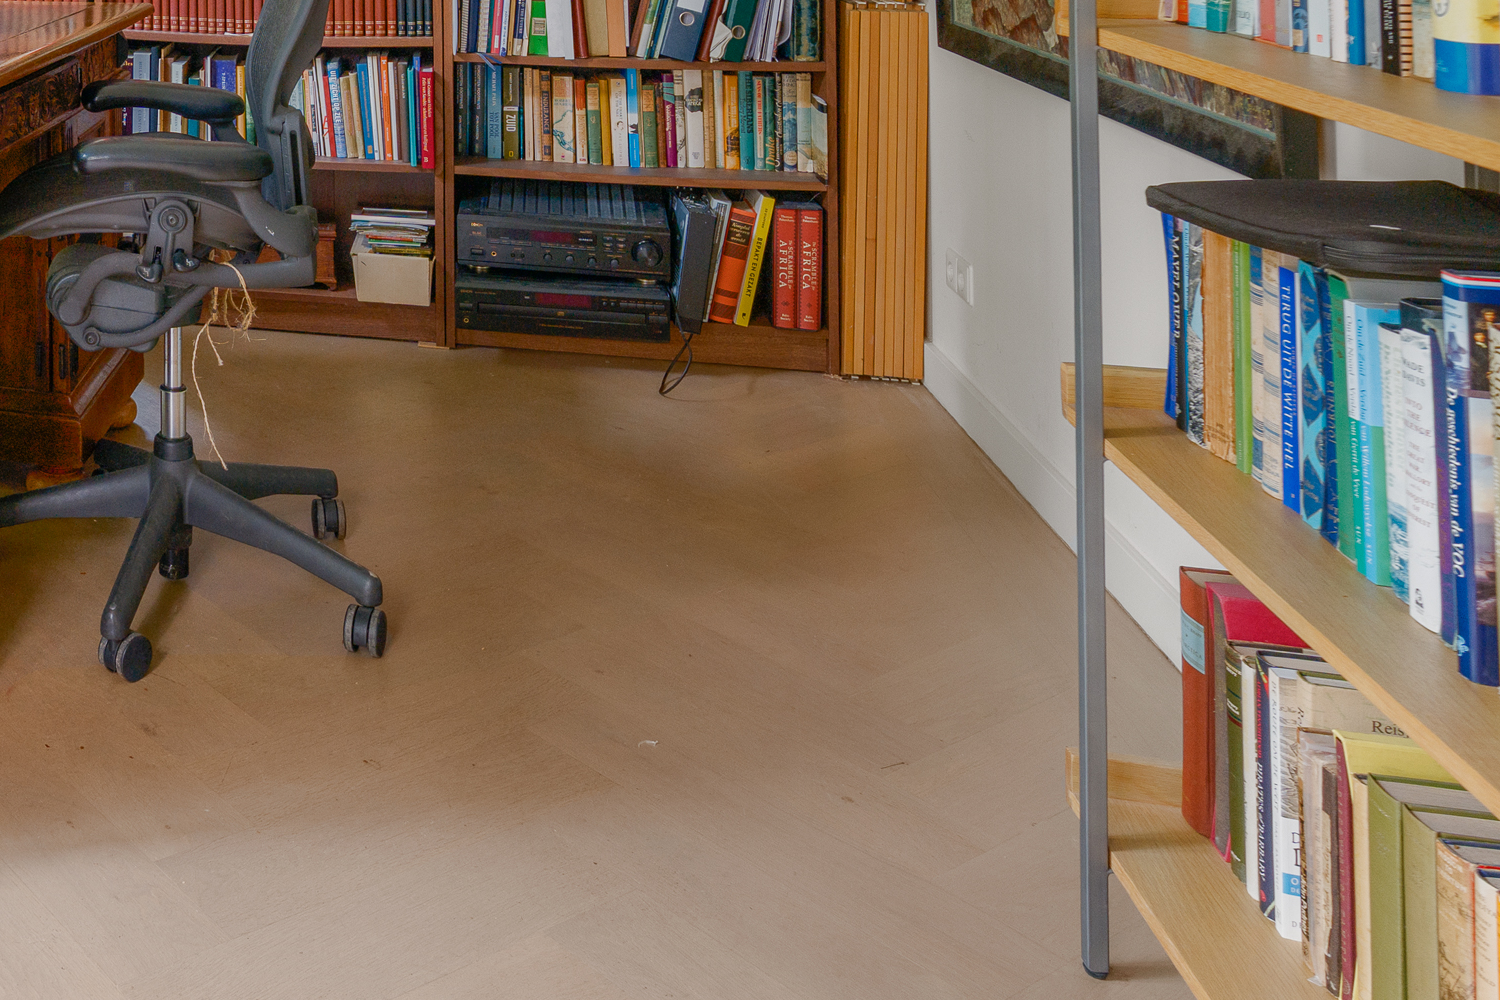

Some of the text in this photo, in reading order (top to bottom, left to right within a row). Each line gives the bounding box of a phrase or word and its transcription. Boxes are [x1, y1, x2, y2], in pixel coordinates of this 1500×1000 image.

[330, 70, 342, 124] UIT ZICHT OP ZEE
[542, 93, 550, 131] ENDURANCE
[506, 114, 516, 132] ZUID
[766, 137, 776, 166] Drake
[746, 237, 763, 297] BEPAKT EN GEZAKT
[779, 240, 787, 288] AFRICA
[802, 241, 811, 290] AFRICA
[1280, 285, 1295, 470] TERUG UIT DE WITTE HEL
[1327, 381, 1337, 444] JOURNEYS
[1350, 420, 1358, 436] van
[1362, 445, 1370, 478] Willem
[1352, 477, 1360, 498] Veer
[1446, 386, 1465, 578] De geschiedenis van de VOC
[1271, 681, 1278, 695] DE
[1372, 720, 1409, 738] Reis
[1273, 743, 1279, 764] OM
[1274, 768, 1279, 784] DE
[1256, 762, 1266, 881] PIRATES BARBARY
